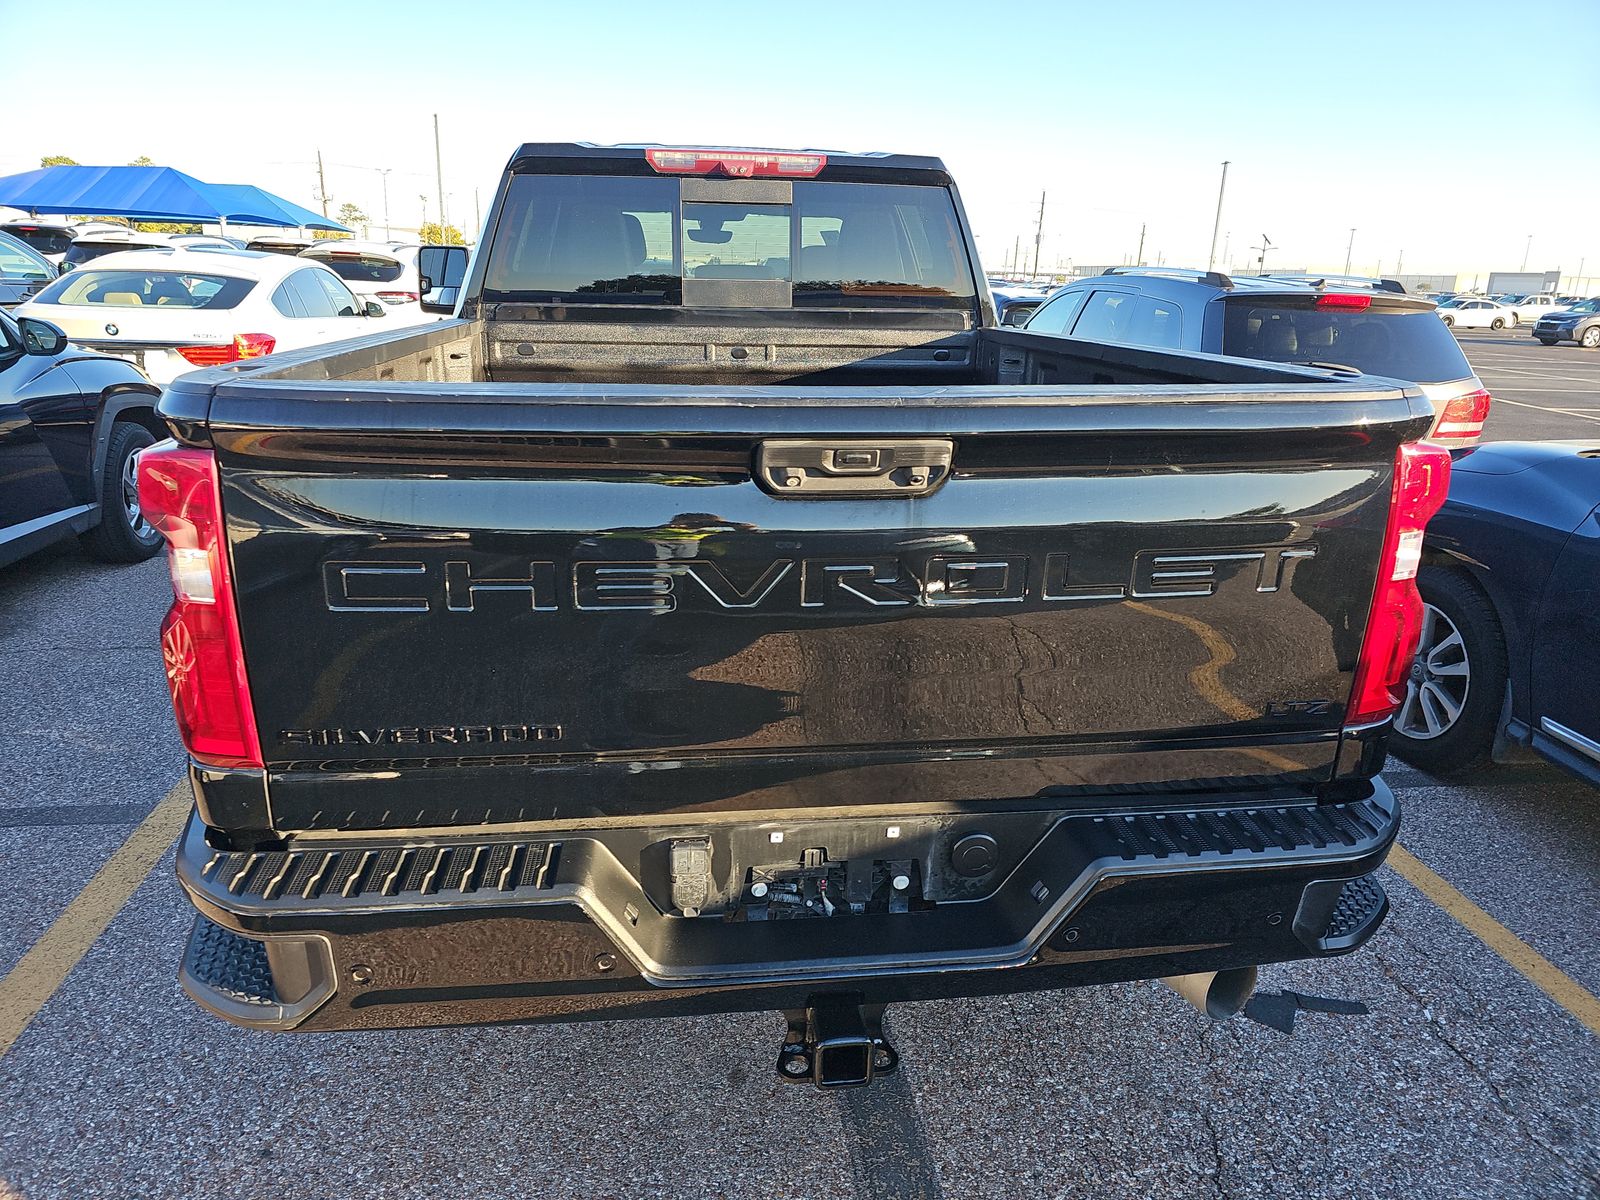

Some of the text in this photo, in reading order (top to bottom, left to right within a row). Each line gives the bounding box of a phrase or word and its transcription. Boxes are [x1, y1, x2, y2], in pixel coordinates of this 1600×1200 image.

[322, 541, 1319, 612] CHEVROLET
[1265, 698, 1330, 717] LTZ
[281, 724, 564, 745] SILVERADO
